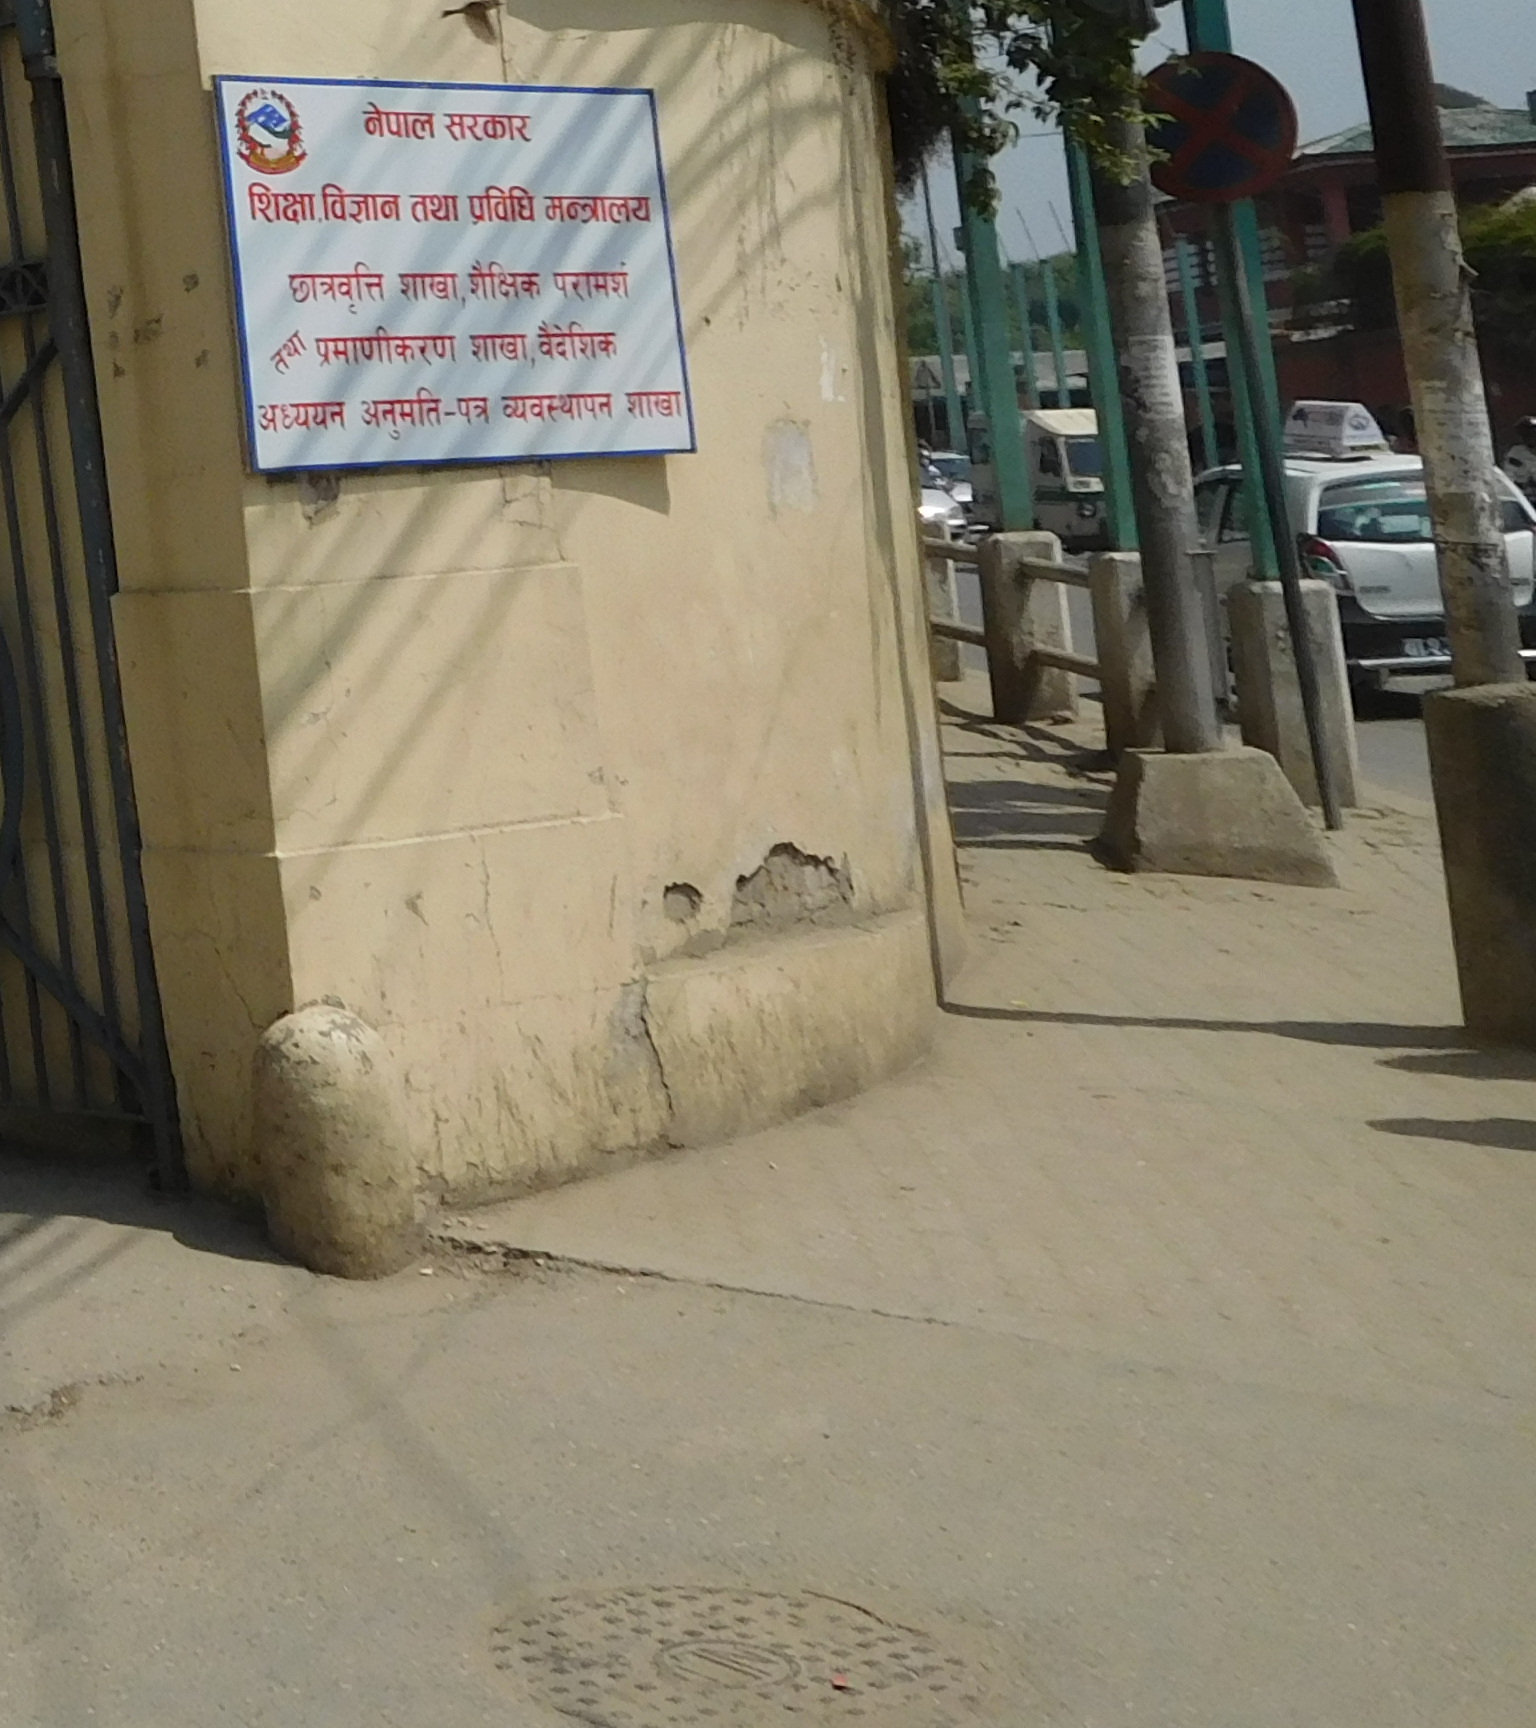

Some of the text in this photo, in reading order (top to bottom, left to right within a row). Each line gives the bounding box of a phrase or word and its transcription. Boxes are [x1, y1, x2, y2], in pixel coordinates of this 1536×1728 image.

[362, 101, 532, 142] नेपाल सरकार
[321, 183, 401, 224] विज्ञान
[409, 194, 460, 223] तथा
[467, 185, 536, 225] प्रविधि
[543, 195, 652, 224] मन्त्रालय
[468, 260, 541, 300] शैक्षिक
[270, 329, 308, 376] तथा
[315, 325, 457, 368] प्रमाणीकरण
[536, 319, 618, 362] वैदेशिक
[257, 400, 347, 434] अध्ययन
[501, 392, 614, 424] व्यवस्थापन
[625, 390, 683, 420] शाखा
